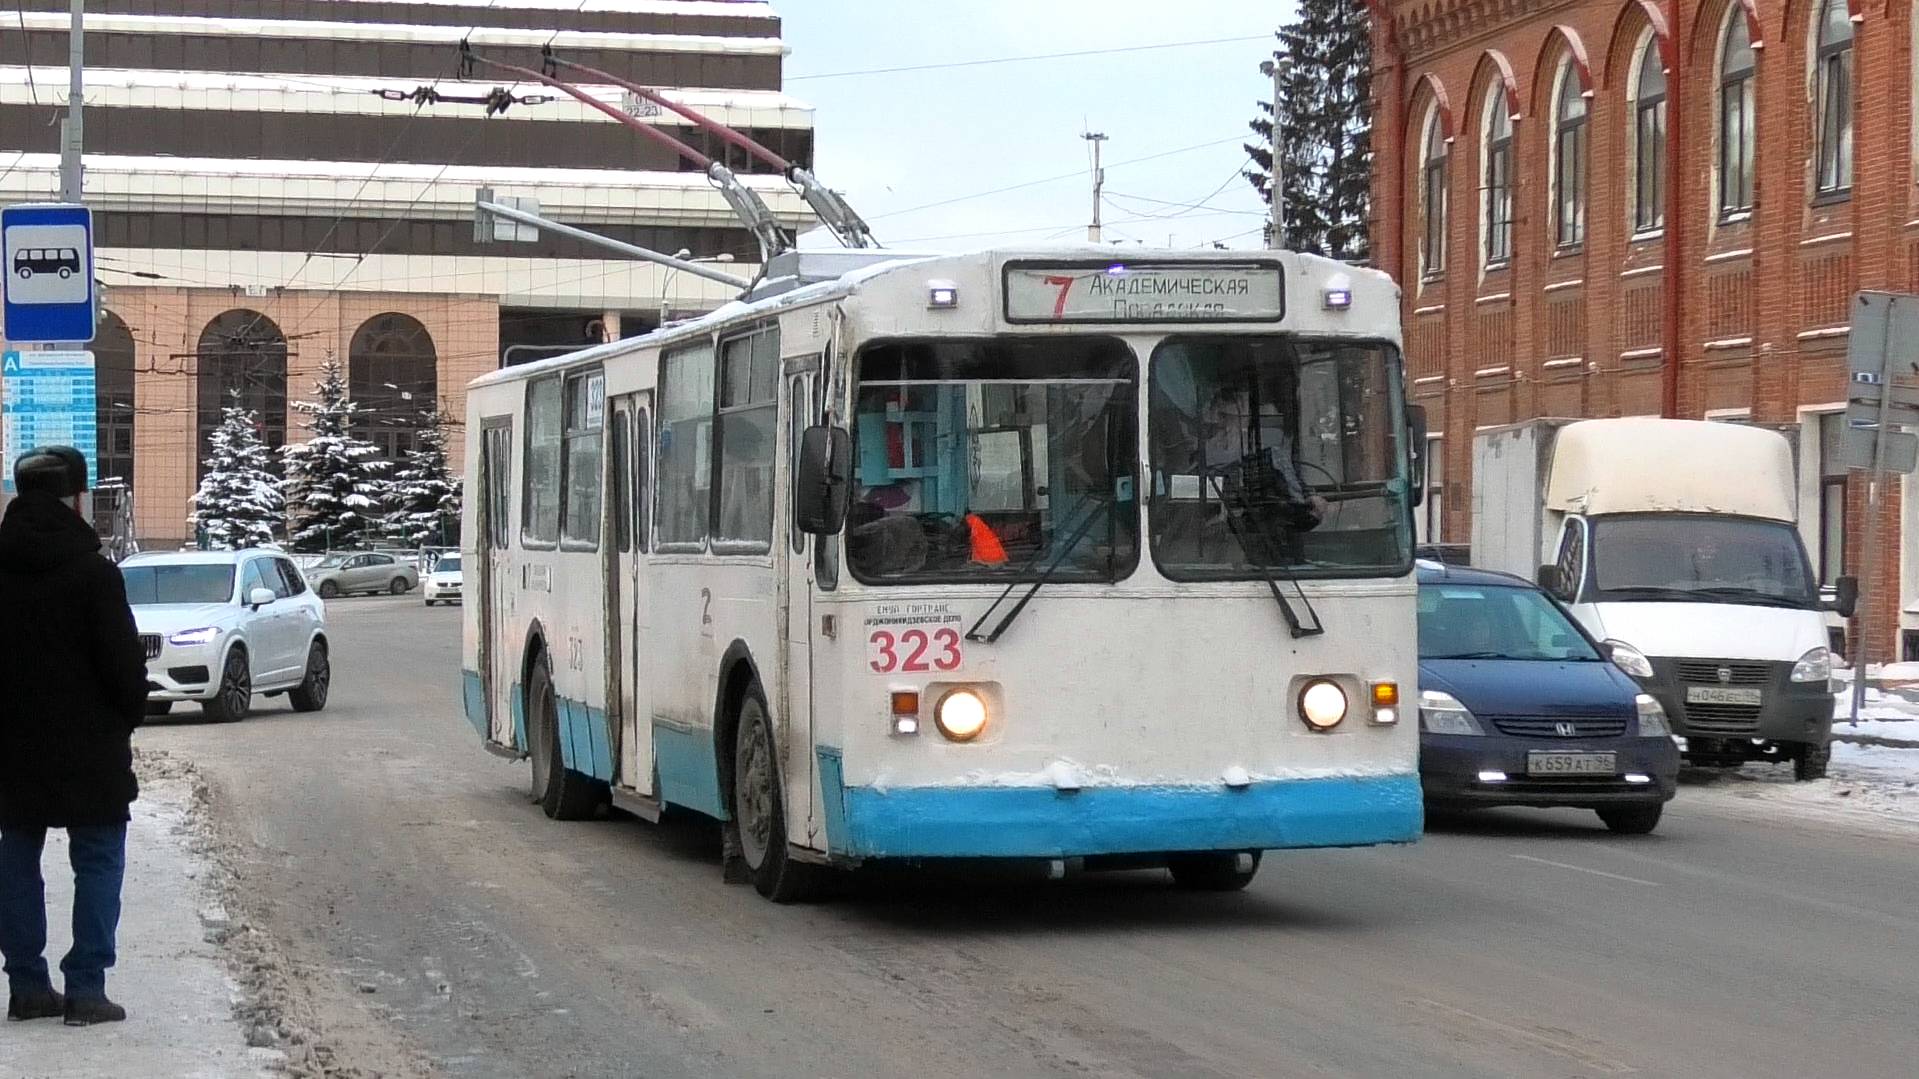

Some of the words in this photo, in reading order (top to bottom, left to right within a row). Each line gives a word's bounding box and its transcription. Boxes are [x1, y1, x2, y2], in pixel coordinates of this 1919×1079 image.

[1043, 276, 1074, 321] 7
[1088, 274, 1250, 296] АКАДЕМИЧЕСКАЯ
[869, 627, 962, 673] 323
